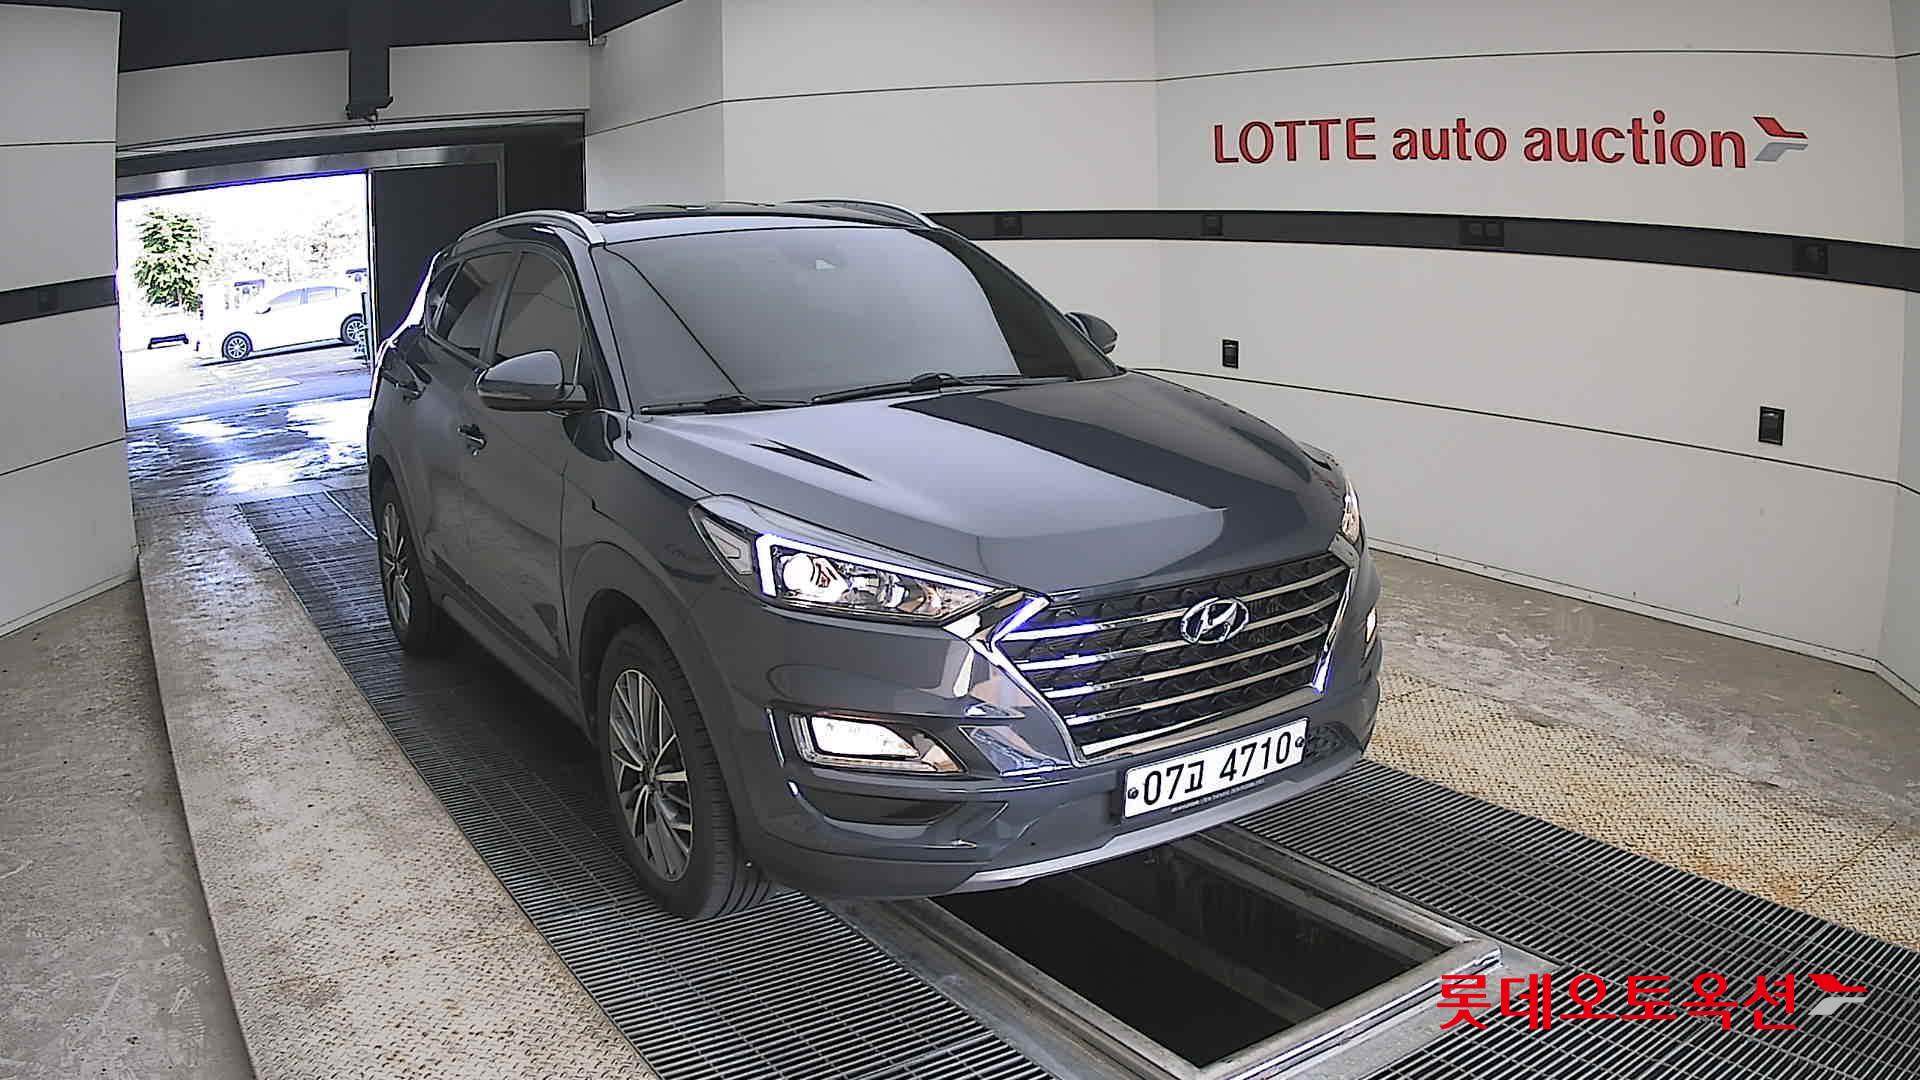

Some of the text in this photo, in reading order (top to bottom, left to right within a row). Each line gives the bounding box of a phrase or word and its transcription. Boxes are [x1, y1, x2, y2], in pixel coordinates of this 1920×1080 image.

[1213, 109, 1747, 169] LOTTE auto auction
[1143, 760, 1204, 806] 07고
[1219, 731, 1291, 782] 4710
